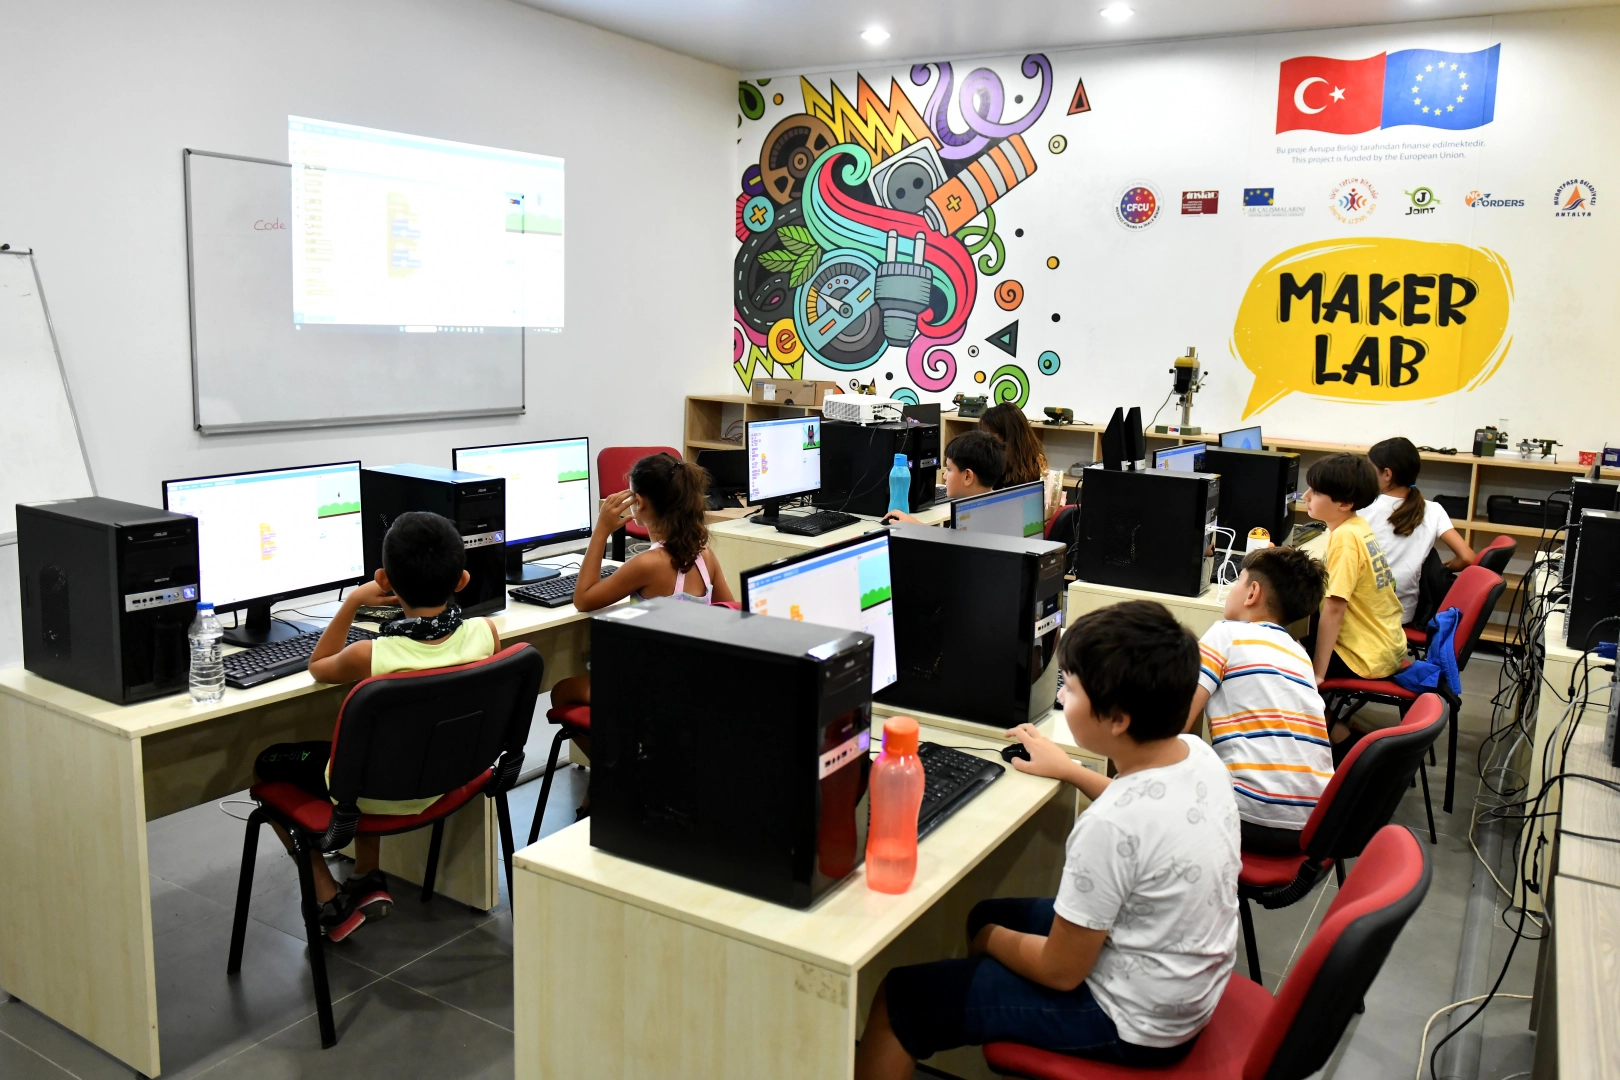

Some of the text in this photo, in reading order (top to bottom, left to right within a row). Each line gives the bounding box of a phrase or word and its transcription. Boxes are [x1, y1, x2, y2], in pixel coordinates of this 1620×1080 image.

[1276, 146, 1286, 154] Bu
[1287, 146, 1307, 155] proje
[1308, 145, 1335, 153] Avrupa
[1337, 144, 1358, 153] Birliği
[1402, 141, 1430, 150] finanse
[1432, 139, 1486, 149] edilmektedir.
[1308, 156, 1335, 164] project
[1343, 154, 1372, 162] funded
[1373, 153, 1383, 163] by
[1385, 153, 1398, 161] the
[1400, 152, 1438, 161] European
[1439, 151, 1467, 159] Union.
[1126, 202, 1150, 212] CFCU
[253, 217, 287, 231] Code
[1276, 270, 1480, 328] MAKER
[1311, 333, 1430, 389] LAB
